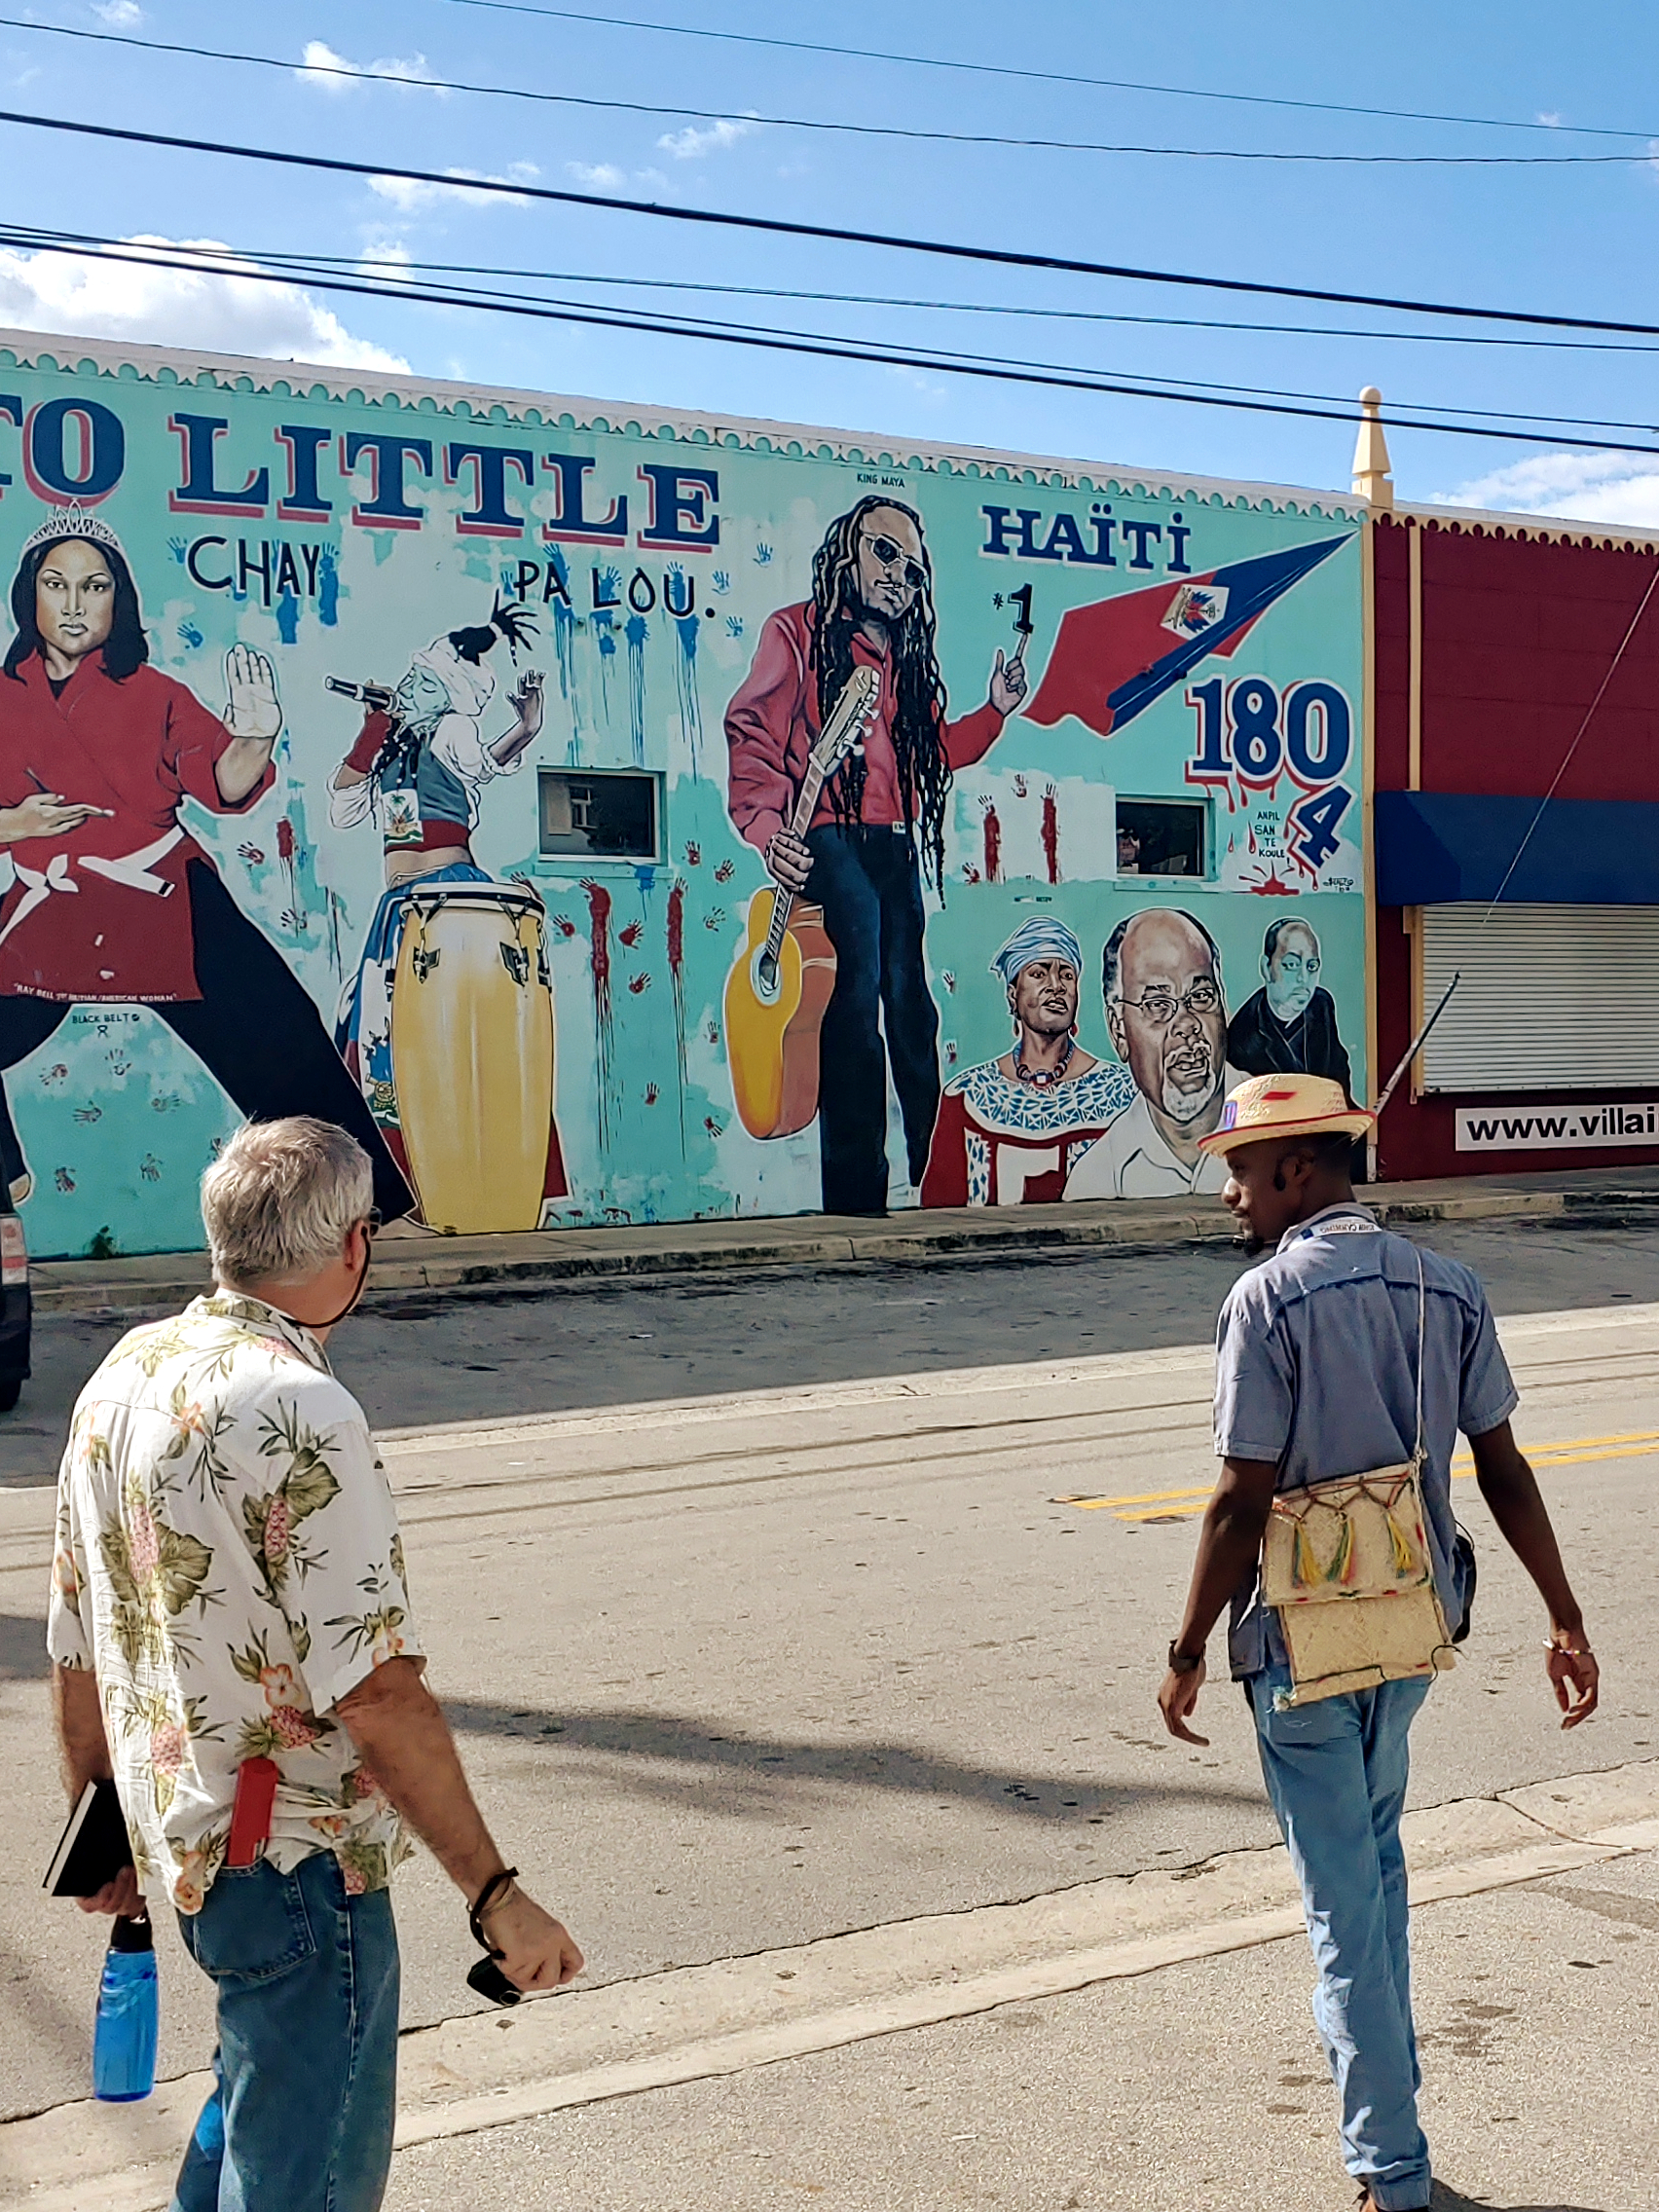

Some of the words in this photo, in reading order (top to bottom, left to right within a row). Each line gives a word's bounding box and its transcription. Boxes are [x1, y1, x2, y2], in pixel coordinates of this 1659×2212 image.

[0, 393, 126, 507] O
[167, 411, 720, 555] LITTLE
[857, 473, 878, 485] KING
[881, 476, 905, 488] MAYA
[187, 535, 320, 608] CHAY
[513, 560, 571, 606] PA
[1185, 676, 1352, 790] 180
[1254, 825, 1275, 835] SAN
[1265, 838, 1276, 847] TE
[72, 1014, 100, 1023] BLACK
[1465, 1106, 1659, 1141] www.villai
